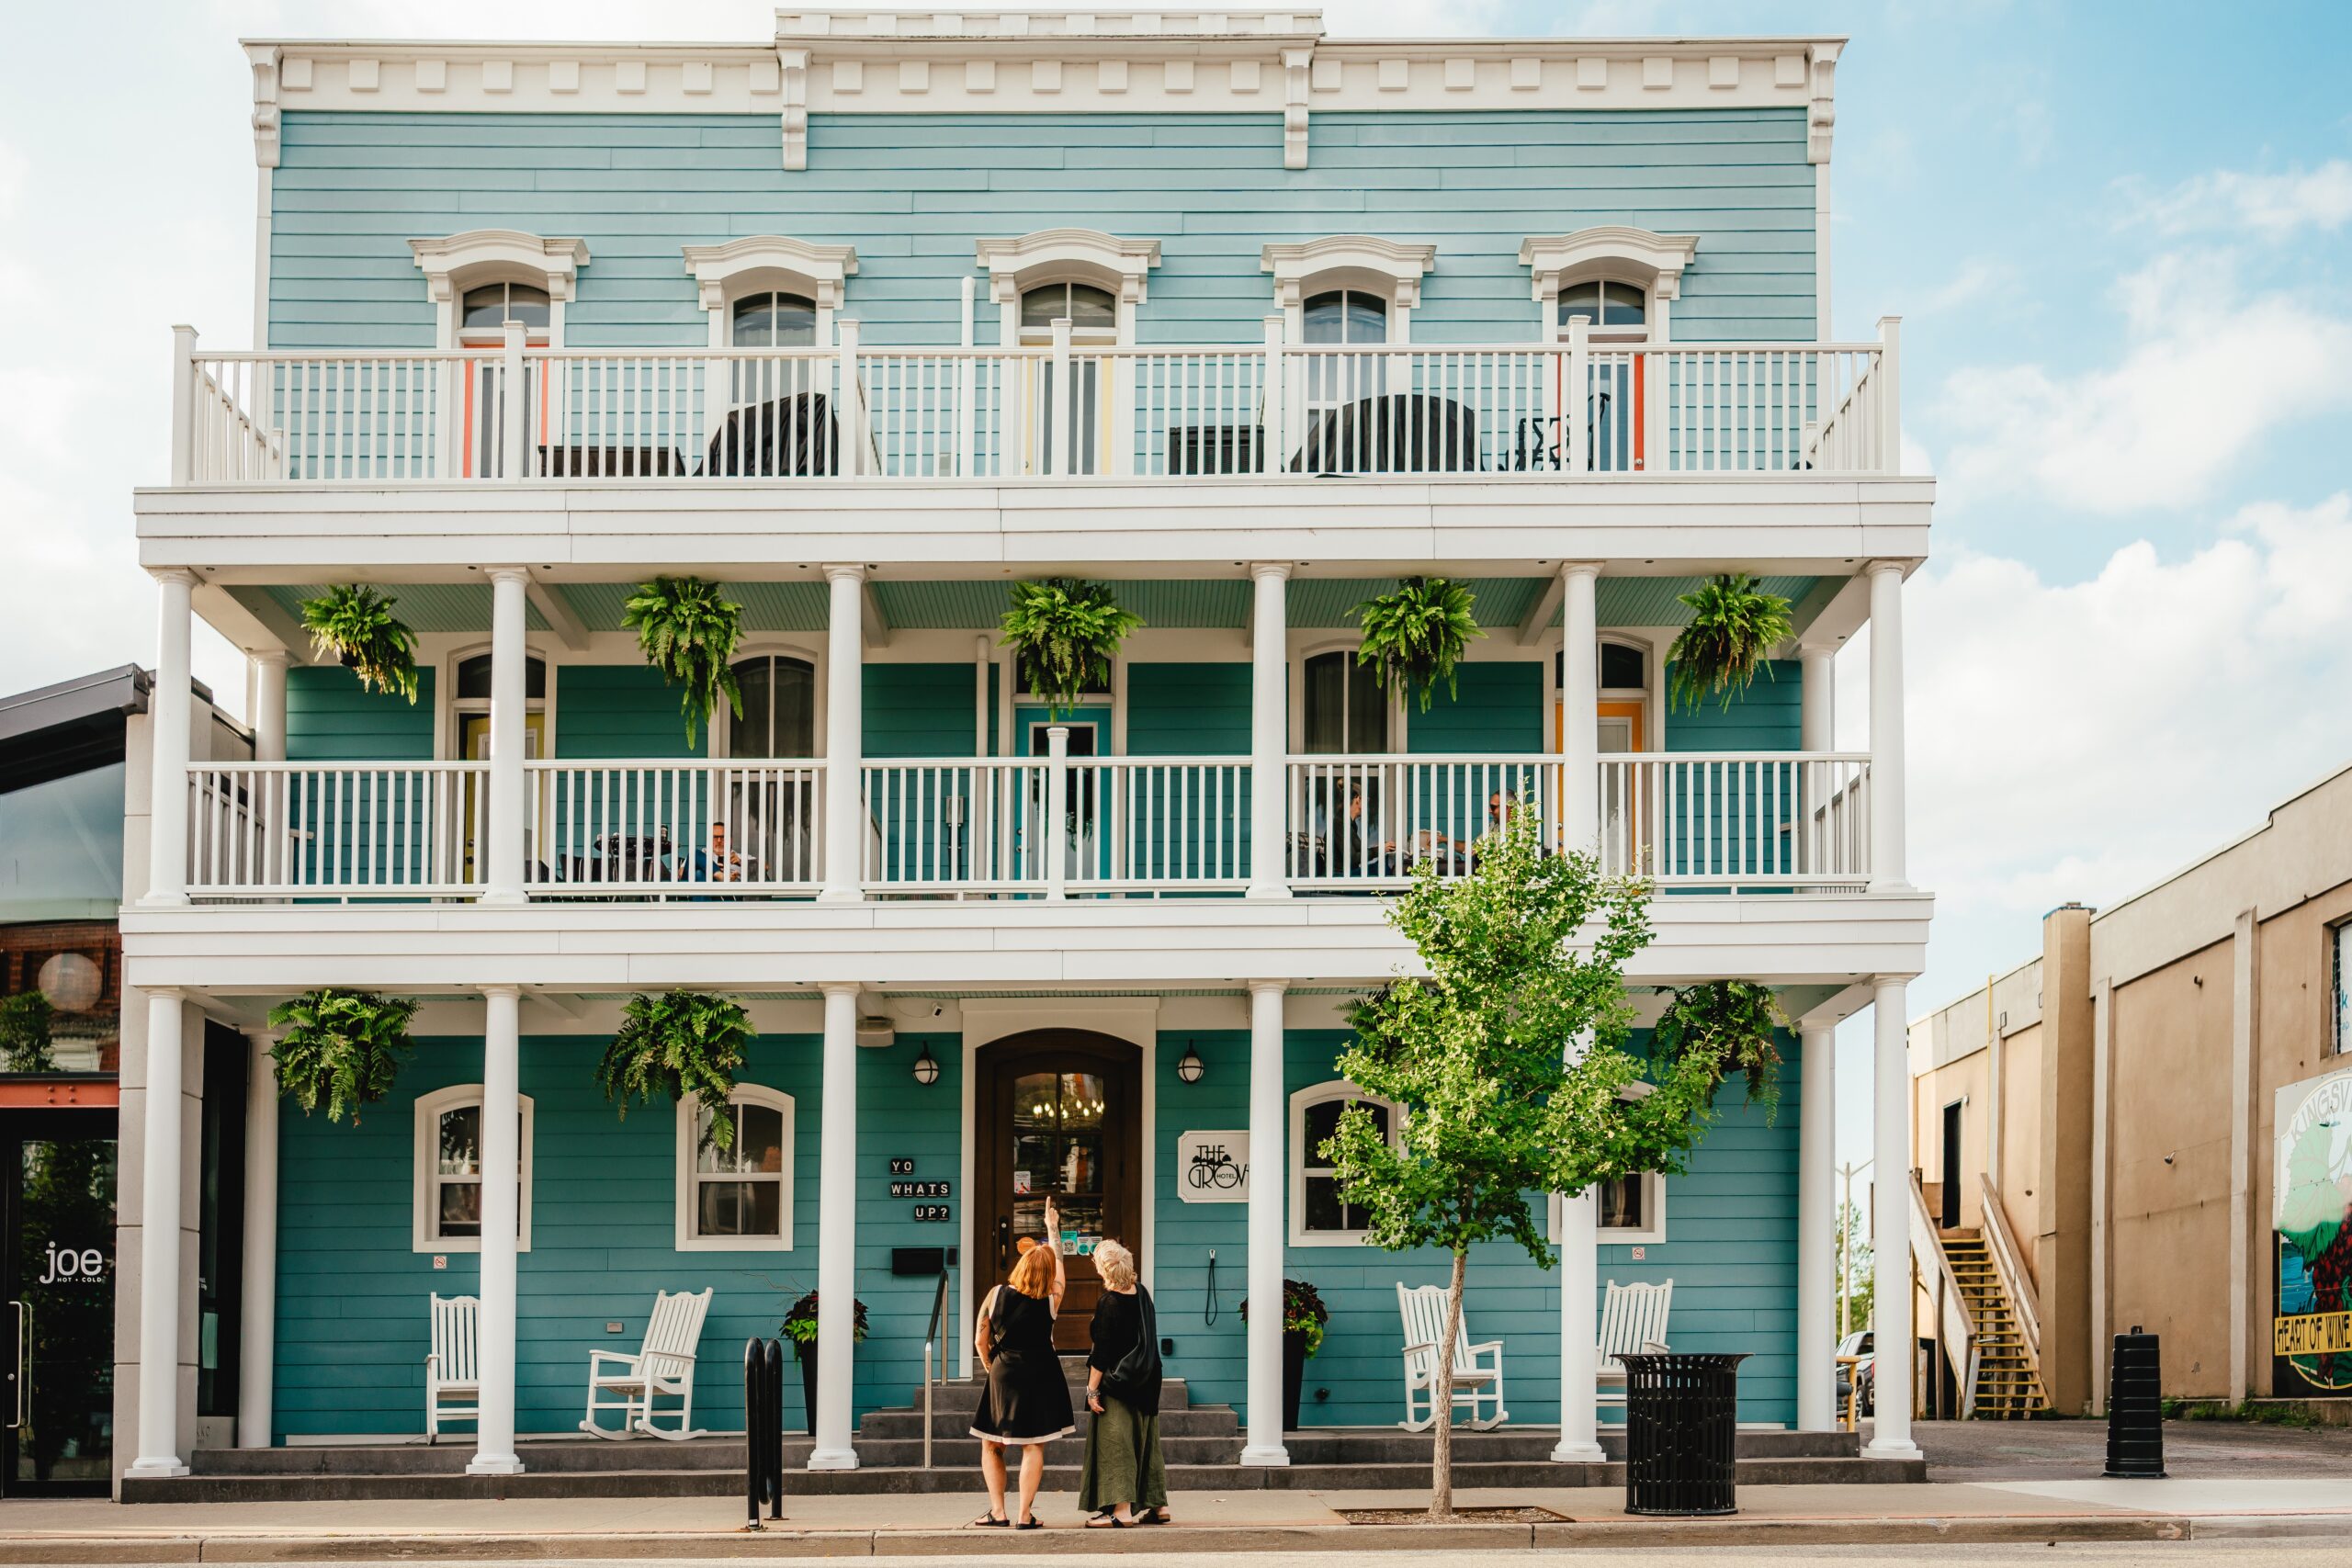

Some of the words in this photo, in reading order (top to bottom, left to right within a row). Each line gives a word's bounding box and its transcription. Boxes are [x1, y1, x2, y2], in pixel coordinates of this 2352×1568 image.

[2291, 1081, 2352, 1142] KINGSV
[1196, 1145, 1225, 1163] THE
[892, 1161, 912, 1171] YO
[1189, 1164, 1249, 1188] GROV
[891, 1184, 948, 1194] WHATS
[915, 1207, 947, 1217] UP?
[40, 1241, 103, 1284] joe
[2278, 1318, 2306, 1352] HEART
[2310, 1317, 2322, 1350] OF
[2325, 1314, 2350, 1349] WINE
